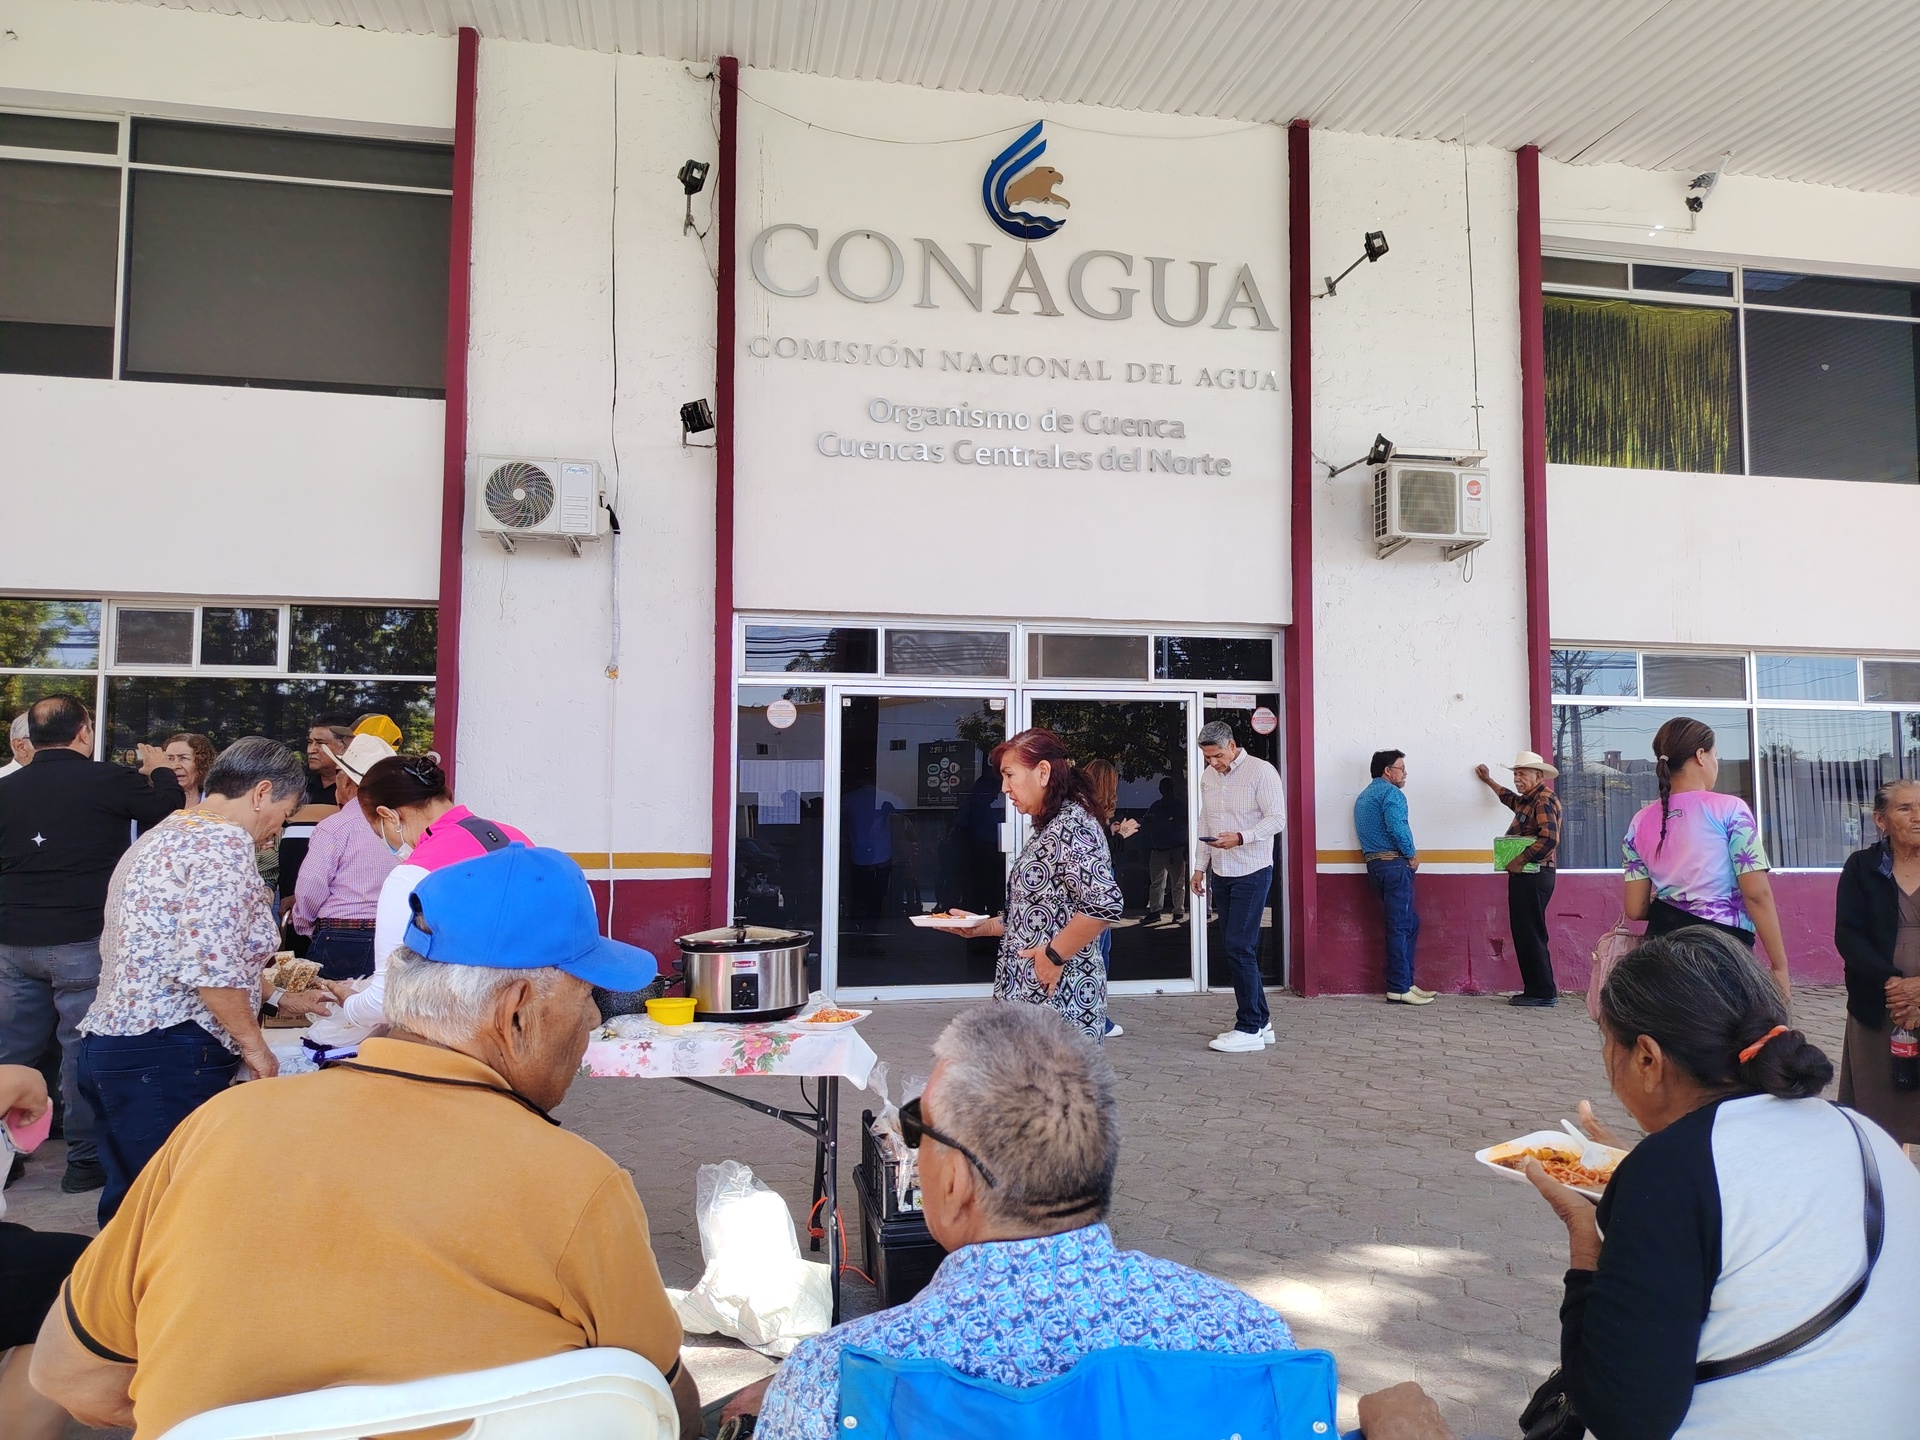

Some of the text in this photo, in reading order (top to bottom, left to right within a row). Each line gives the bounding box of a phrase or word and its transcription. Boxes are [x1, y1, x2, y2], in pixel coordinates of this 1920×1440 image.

[751, 223, 1280, 332] CONAGUA
[748, 335, 1280, 392] COMISIÓN NACIONAL DEL AGUA
[867, 396, 1187, 440] Organismo de Cuenca
[816, 430, 1233, 477] Cuencas Centrales del Norte
